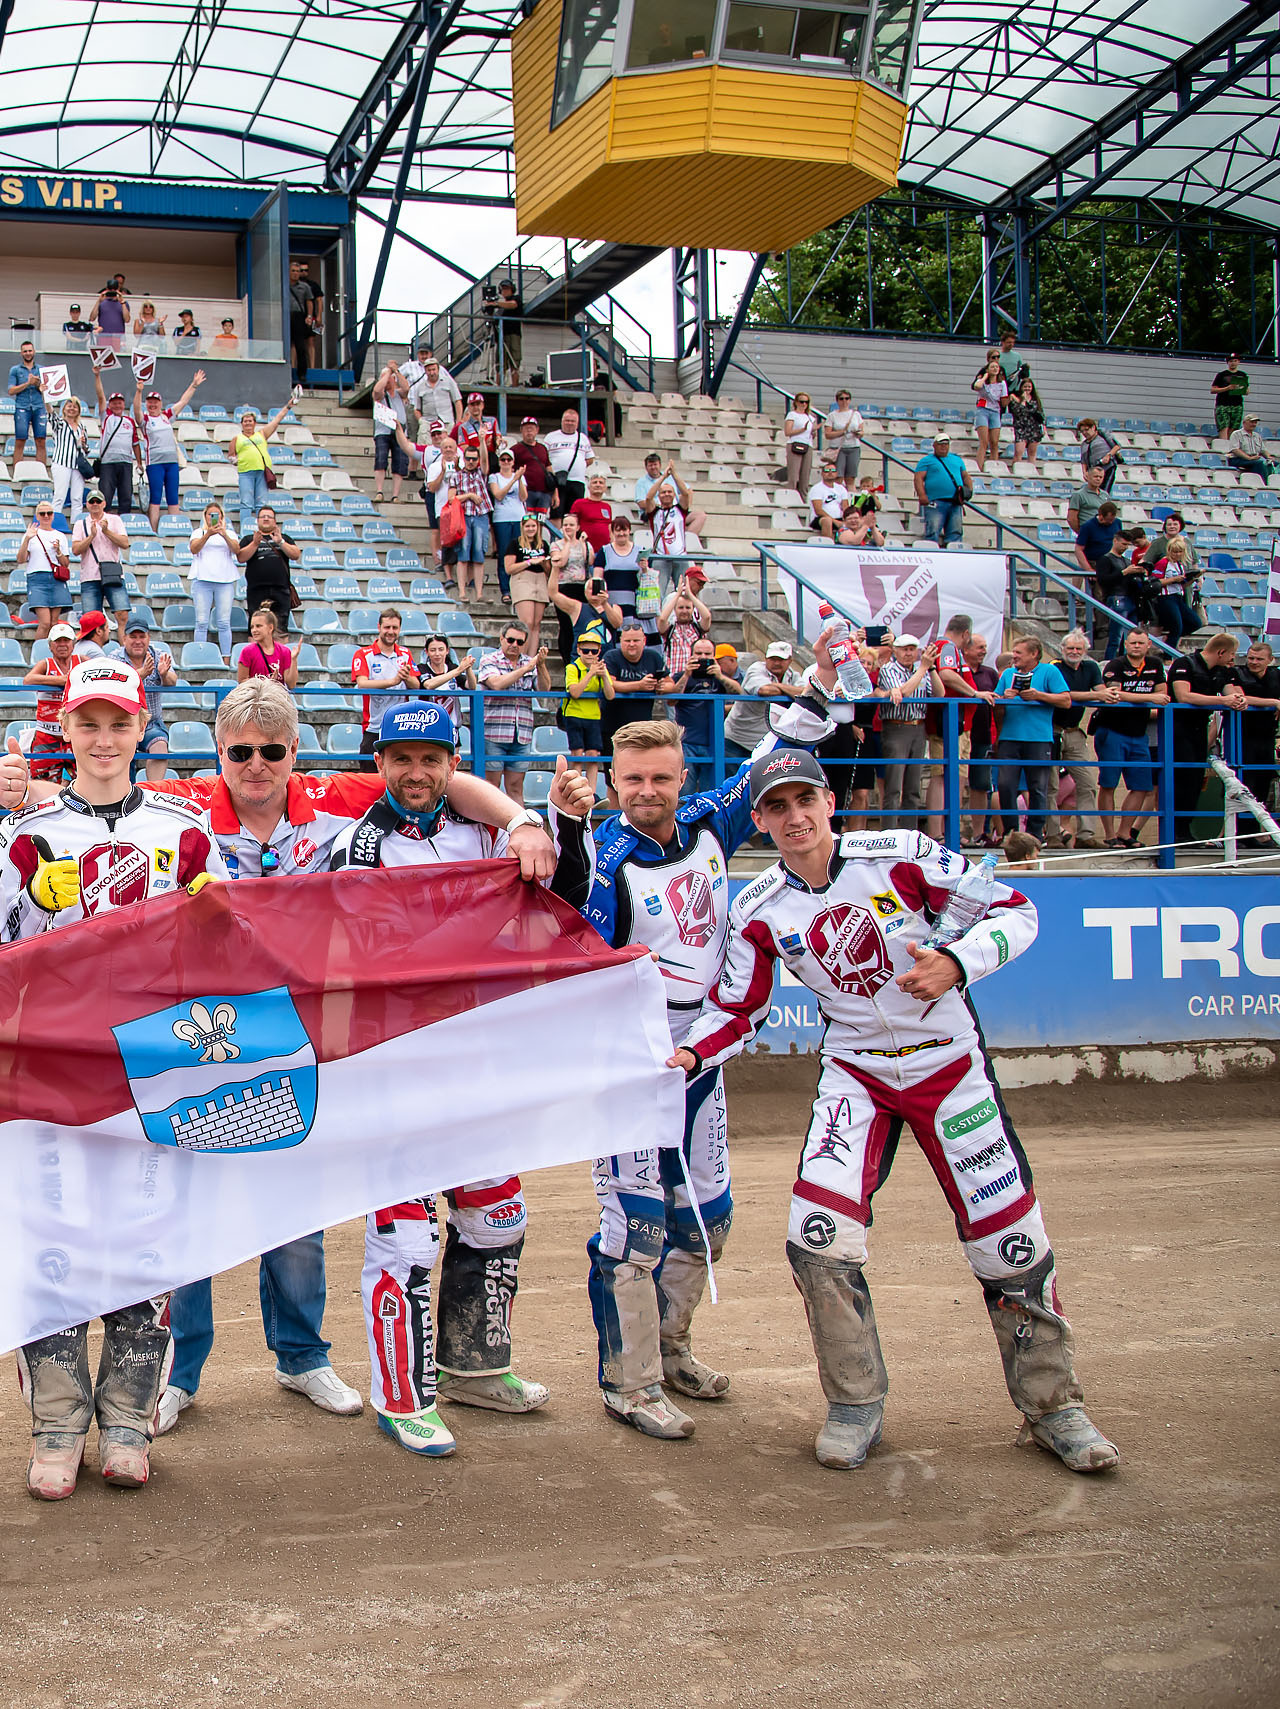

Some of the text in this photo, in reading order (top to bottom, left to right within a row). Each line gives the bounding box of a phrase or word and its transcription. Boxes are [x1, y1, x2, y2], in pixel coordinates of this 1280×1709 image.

[37, 180, 123, 210] V.I.P.
[857, 553, 935, 565] DAUGAVPILS
[877, 568, 934, 628] OKOMOTIV
[398, 721, 422, 732] LIFTS
[305, 786, 327, 800] 63
[847, 837, 897, 848] GORINA
[85, 852, 140, 900] LOKOMOTIV
[680, 875, 701, 922] LOKOMOTIV
[824, 908, 862, 967] LOKOMOTIV
[1188, 994, 1235, 1017] CAR
[948, 1105, 994, 1134] G-STOCK
[971, 1150, 1007, 1175] FAMILY
[968, 1166, 1019, 1205] ewinner
[492, 1211, 525, 1228] PRODUCTS
